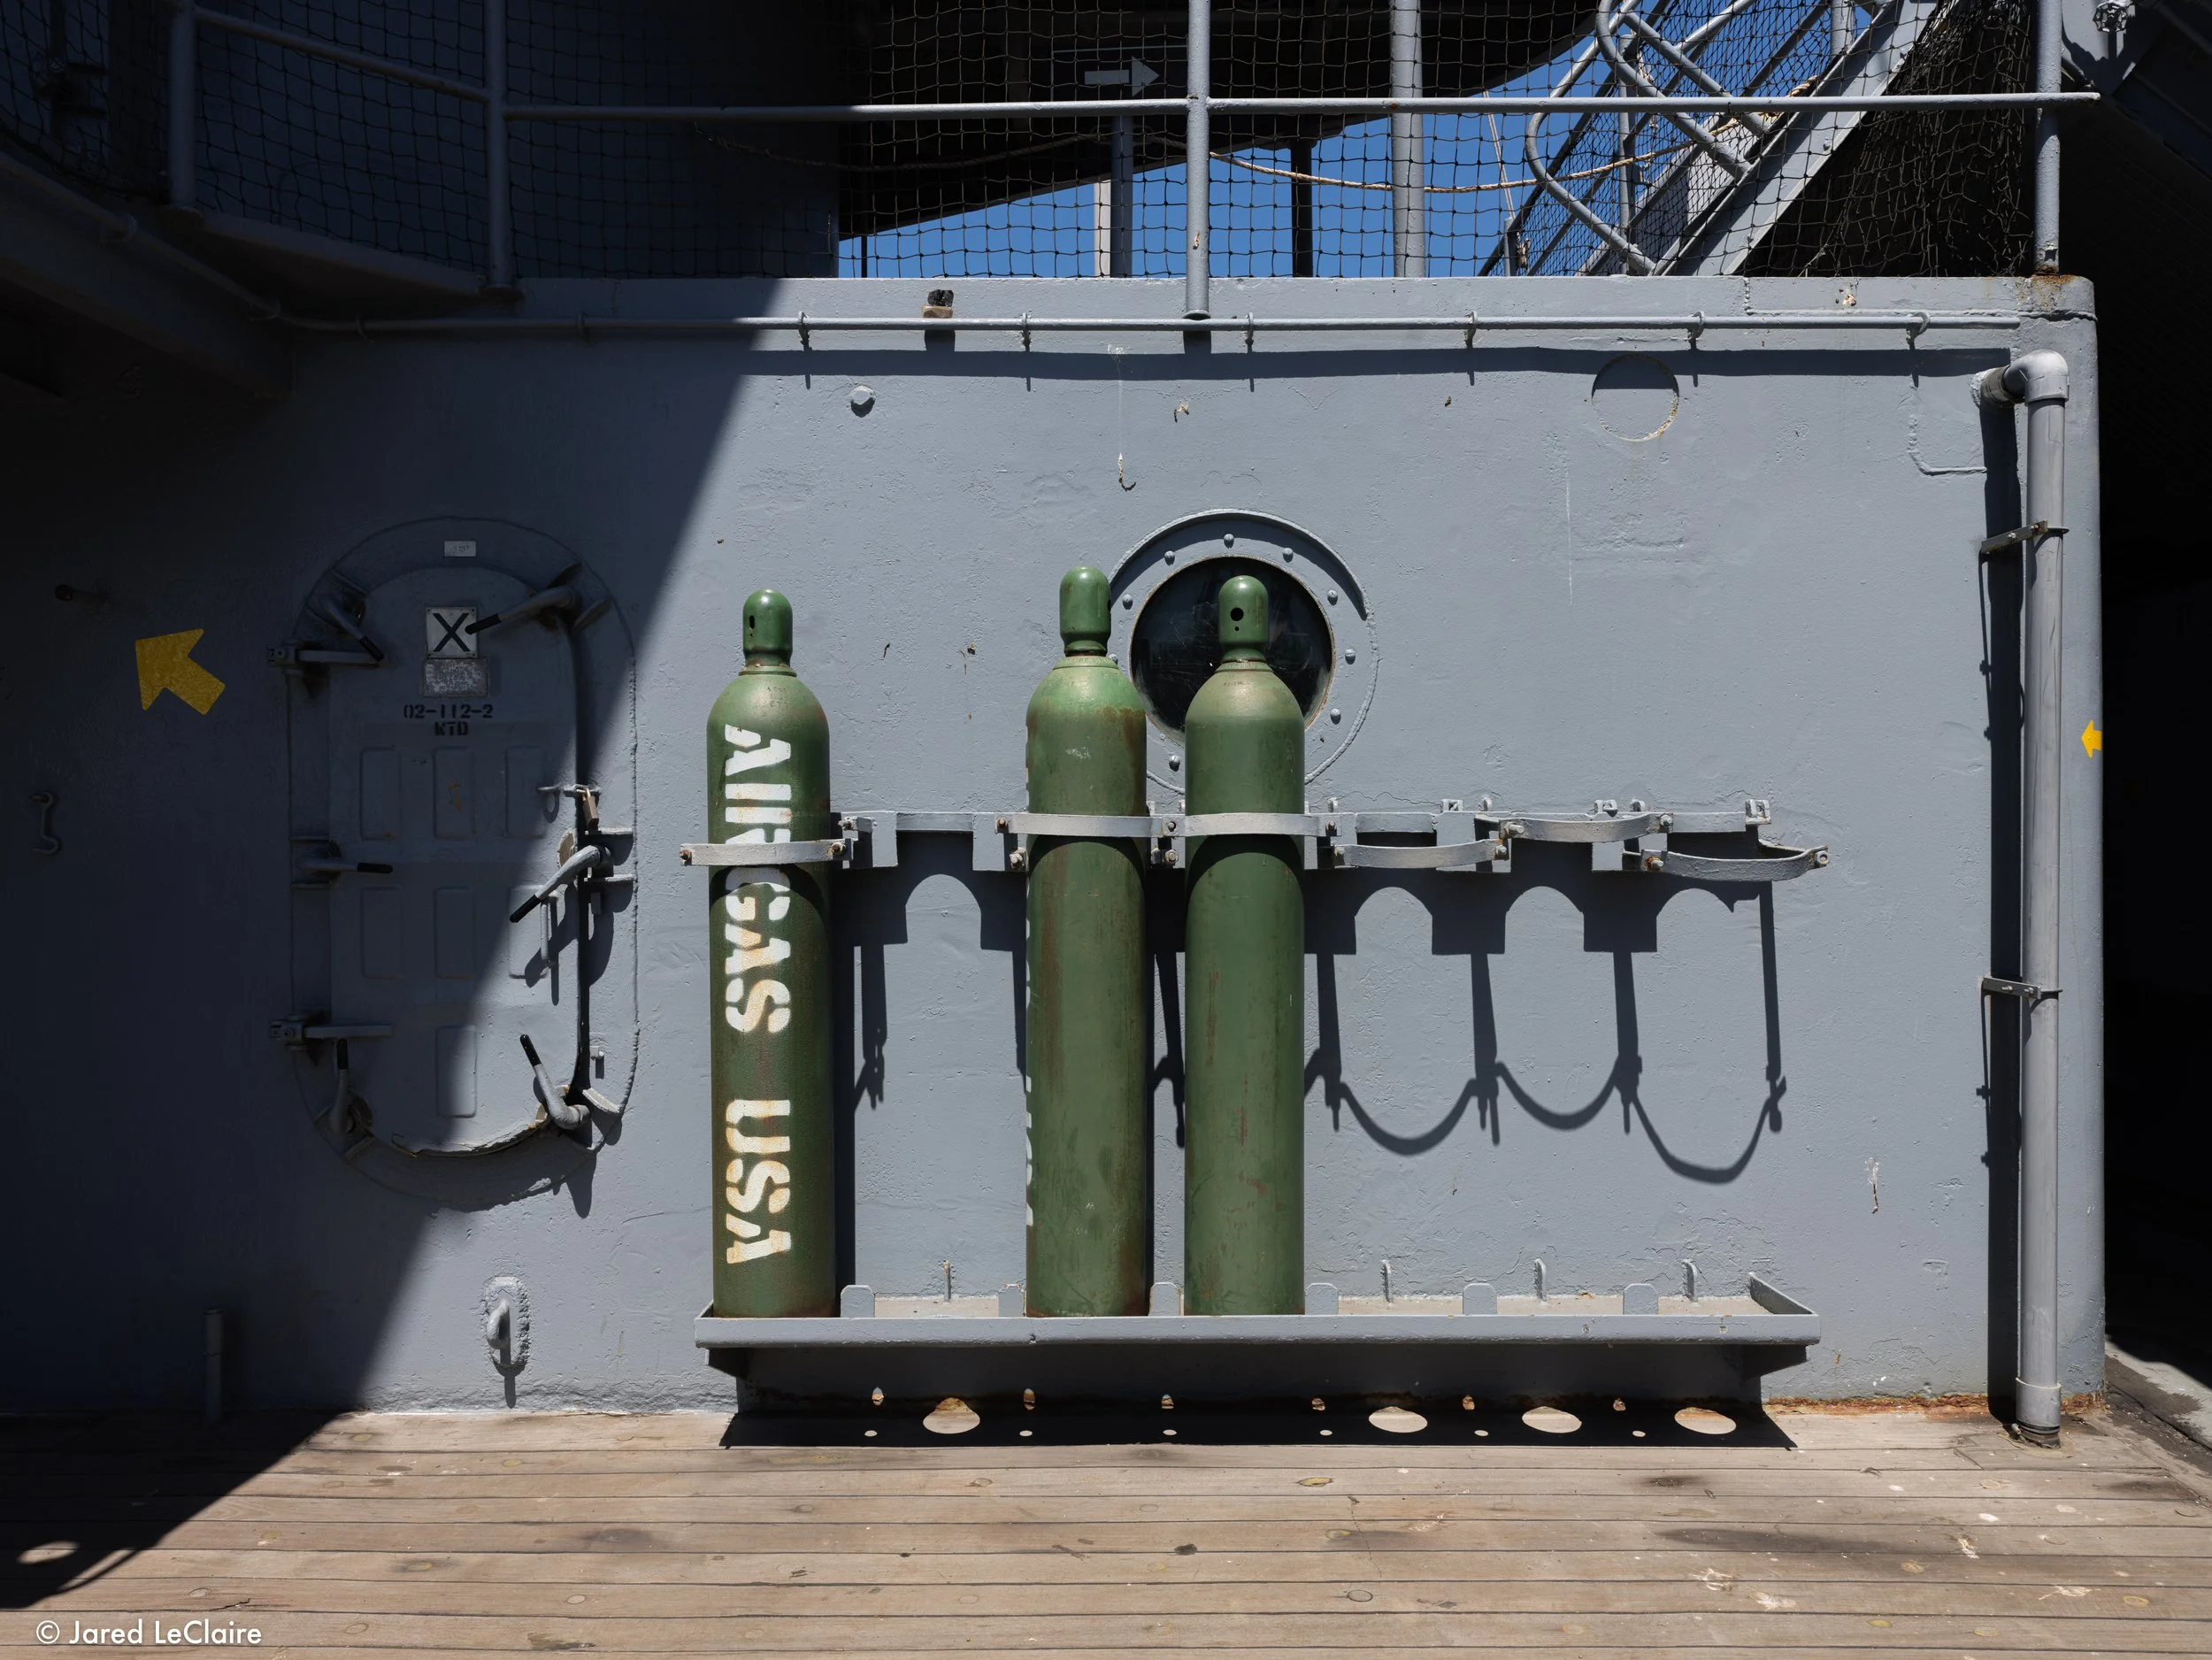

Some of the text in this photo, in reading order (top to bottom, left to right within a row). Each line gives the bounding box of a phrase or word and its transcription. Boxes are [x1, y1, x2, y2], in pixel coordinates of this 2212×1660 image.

[432, 612, 471, 652] X
[403, 704, 494, 719] 02-112-2
[726, 1099, 792, 1264] USA
